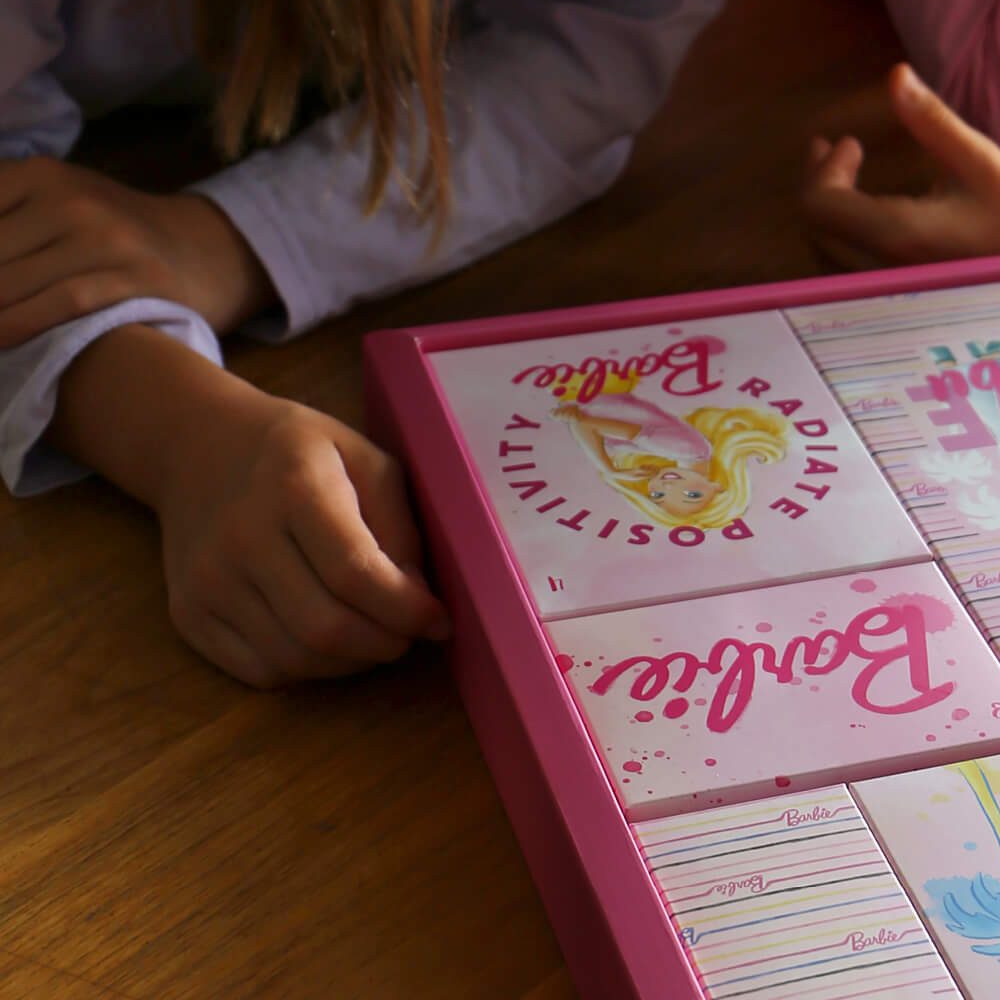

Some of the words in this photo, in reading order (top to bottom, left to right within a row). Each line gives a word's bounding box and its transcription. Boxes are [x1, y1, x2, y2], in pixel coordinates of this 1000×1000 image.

[511, 333, 724, 405] Barbie
[587, 604, 957, 733] Barbie
[782, 806, 833, 827] Barbie
[713, 874, 767, 897] Barbie
[849, 928, 901, 952] Barbie
